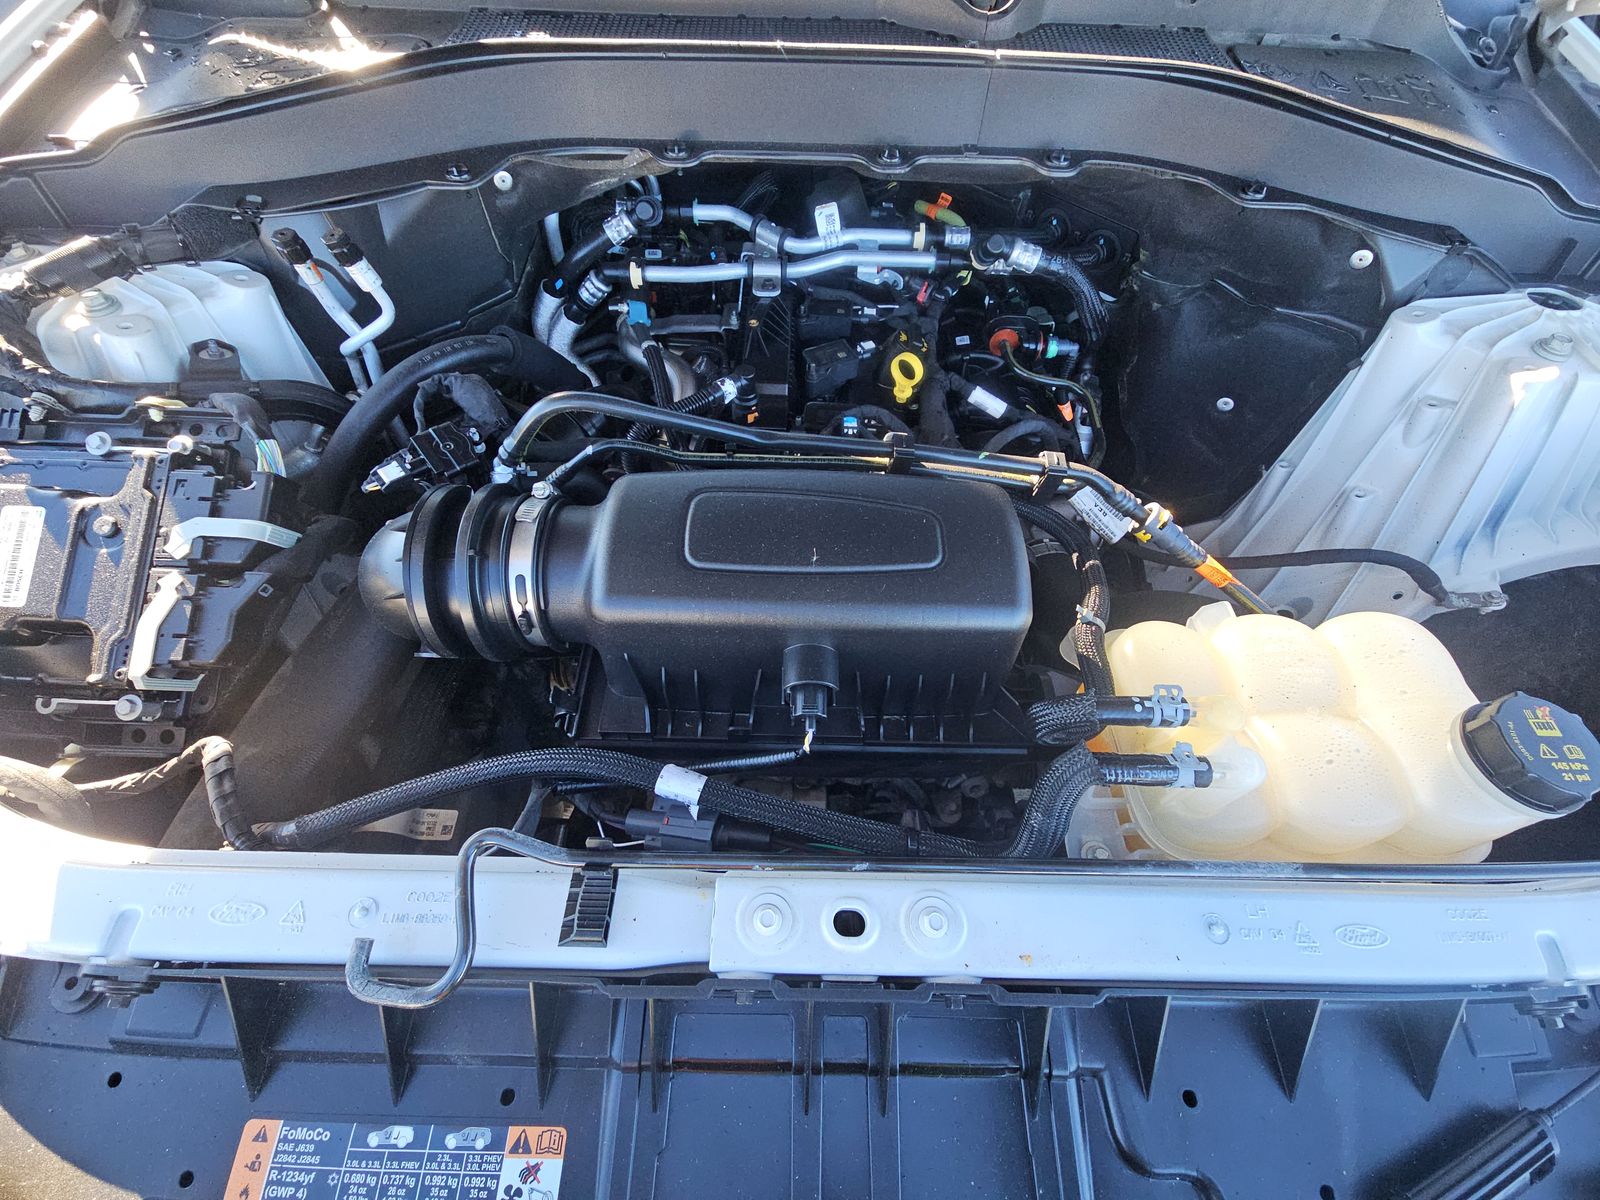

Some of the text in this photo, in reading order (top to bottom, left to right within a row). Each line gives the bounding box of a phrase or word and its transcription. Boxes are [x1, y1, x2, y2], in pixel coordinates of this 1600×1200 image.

[1551, 761, 1590, 771] 145 kPa
[1562, 772, 1591, 783] 21 psi
[280, 1126, 331, 1141] FoMoCo
[277, 1142, 315, 1152] SAE J639
[273, 1154, 320, 1164] J2842 J2845
[468, 1154, 503, 1163] 3.3L FHEV
[360, 1160, 367, 1168] &
[385, 1161, 420, 1170] 3.3L FHEV
[425, 1162, 461, 1171] 3.0L & 3.3L
[481, 1163, 501, 1171] PHEV
[269, 1169, 316, 1186] R-1234yf
[343, 1173, 377, 1187] 0.680 kg
[382, 1174, 416, 1188] 0.737 kg
[424, 1175, 459, 1189] 0.992 kg
[463, 1176, 498, 1190] 0.992 kg
[264, 1185, 307, 1199] (GWP 4)
[348, 1185, 368, 1195] 24 oz
[397, 1188, 407, 1196] oz
[430, 1187, 449, 1197] 35 oz
[469, 1188, 488, 1198] 35 oz
